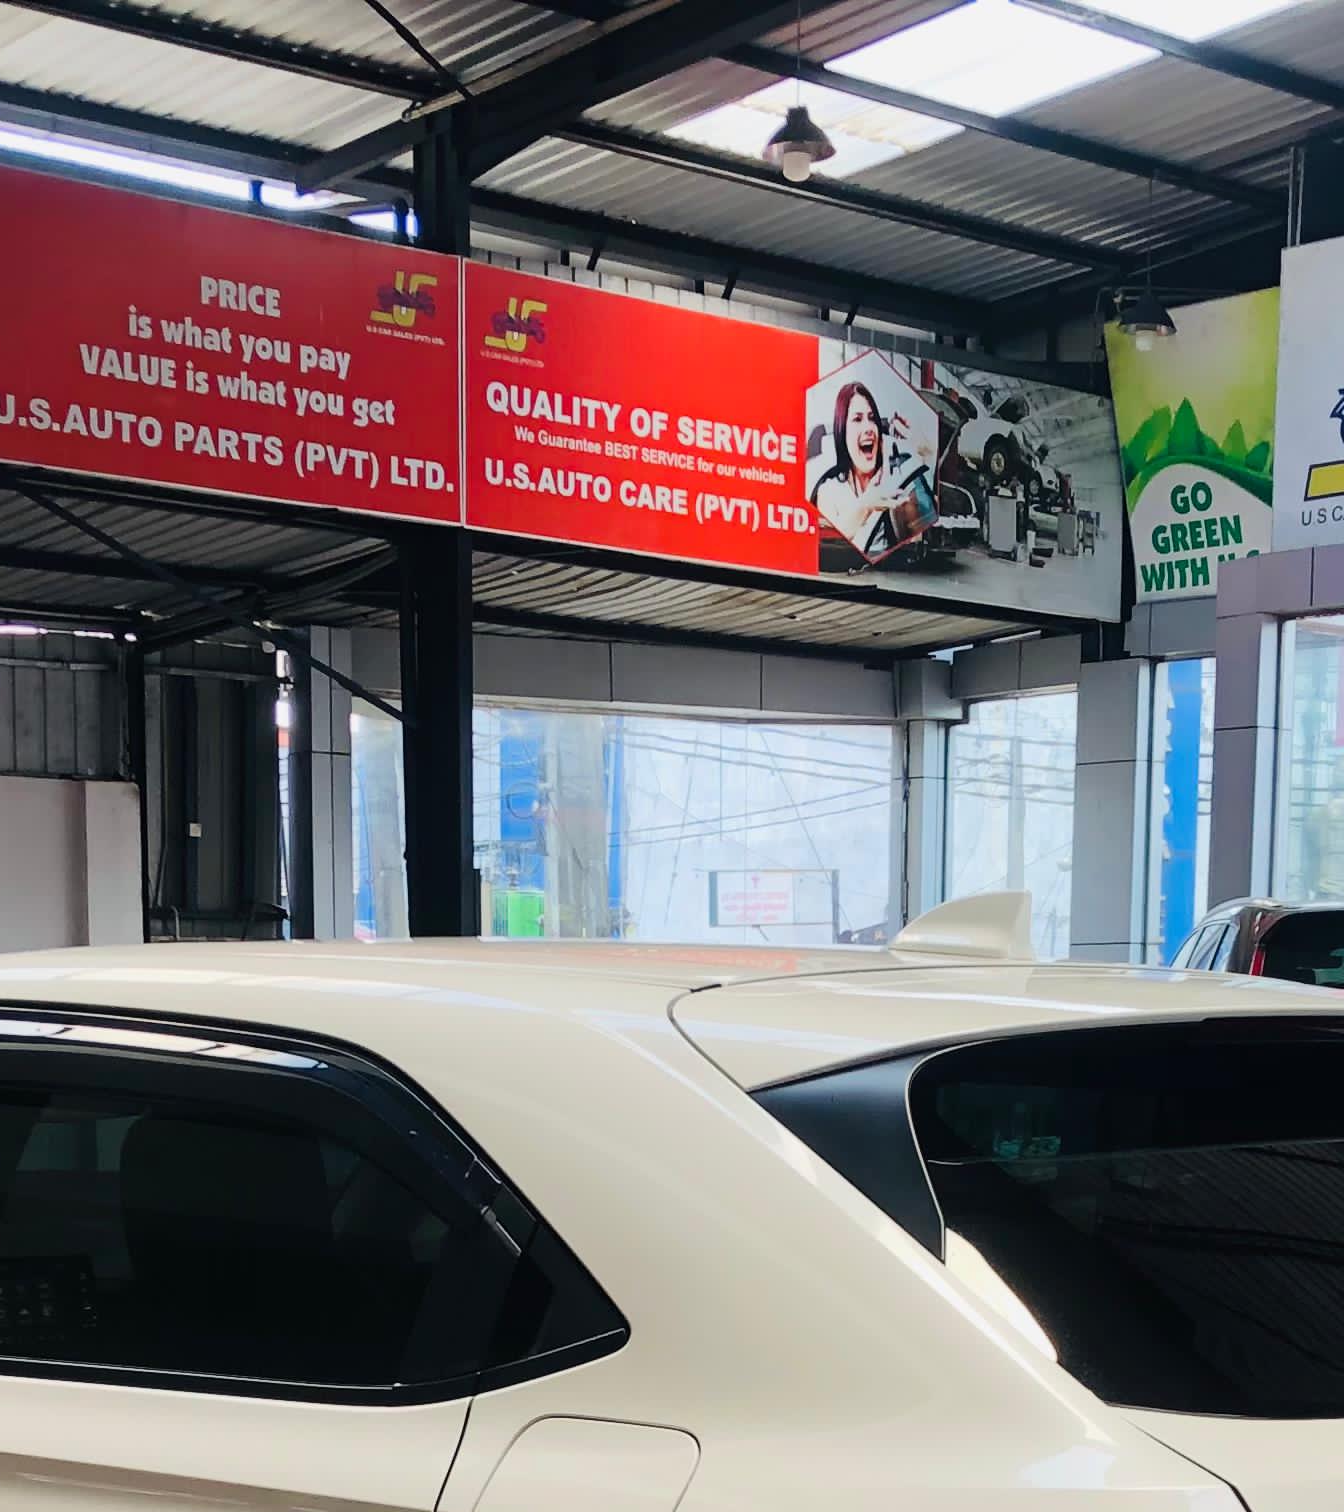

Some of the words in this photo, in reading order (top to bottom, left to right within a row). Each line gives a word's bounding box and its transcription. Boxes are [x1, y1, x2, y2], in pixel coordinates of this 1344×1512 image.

[200, 275, 281, 318] PRICE
[128, 305, 153, 339] is
[160, 316, 232, 354] what
[239, 333, 291, 366] you
[300, 343, 352, 380] pay
[79, 343, 177, 389] VALUE
[185, 361, 209, 394] is
[217, 370, 286, 408] what
[293, 386, 344, 417] you
[352, 398, 396, 428] get
[486, 381, 622, 432] QUALITY
[630, 407, 669, 440] OF
[676, 415, 797, 464] SERVICE
[514, 425, 534, 443] We
[538, 430, 601, 454] Guarantee
[605, 441, 639, 461] BEST
[641, 447, 695, 471] SERVICE
[697, 456, 714, 473] for
[717, 463, 737, 477] our
[738, 465, 785, 485] vehicles
[174, 421, 284, 467] PARTS
[294, 439, 380, 489] (PVT)
[390, 456, 455, 492] LTD.
[485, 457, 611, 502] U.S.AUTO
[620, 480, 688, 515] CARE
[696, 493, 760, 533] (PVT)
[767, 503, 816, 534] LTD.
[1170, 481, 1212, 514] GO
[1151, 514, 1243, 554] GREEN
[1140, 556, 1210, 593] WITH
